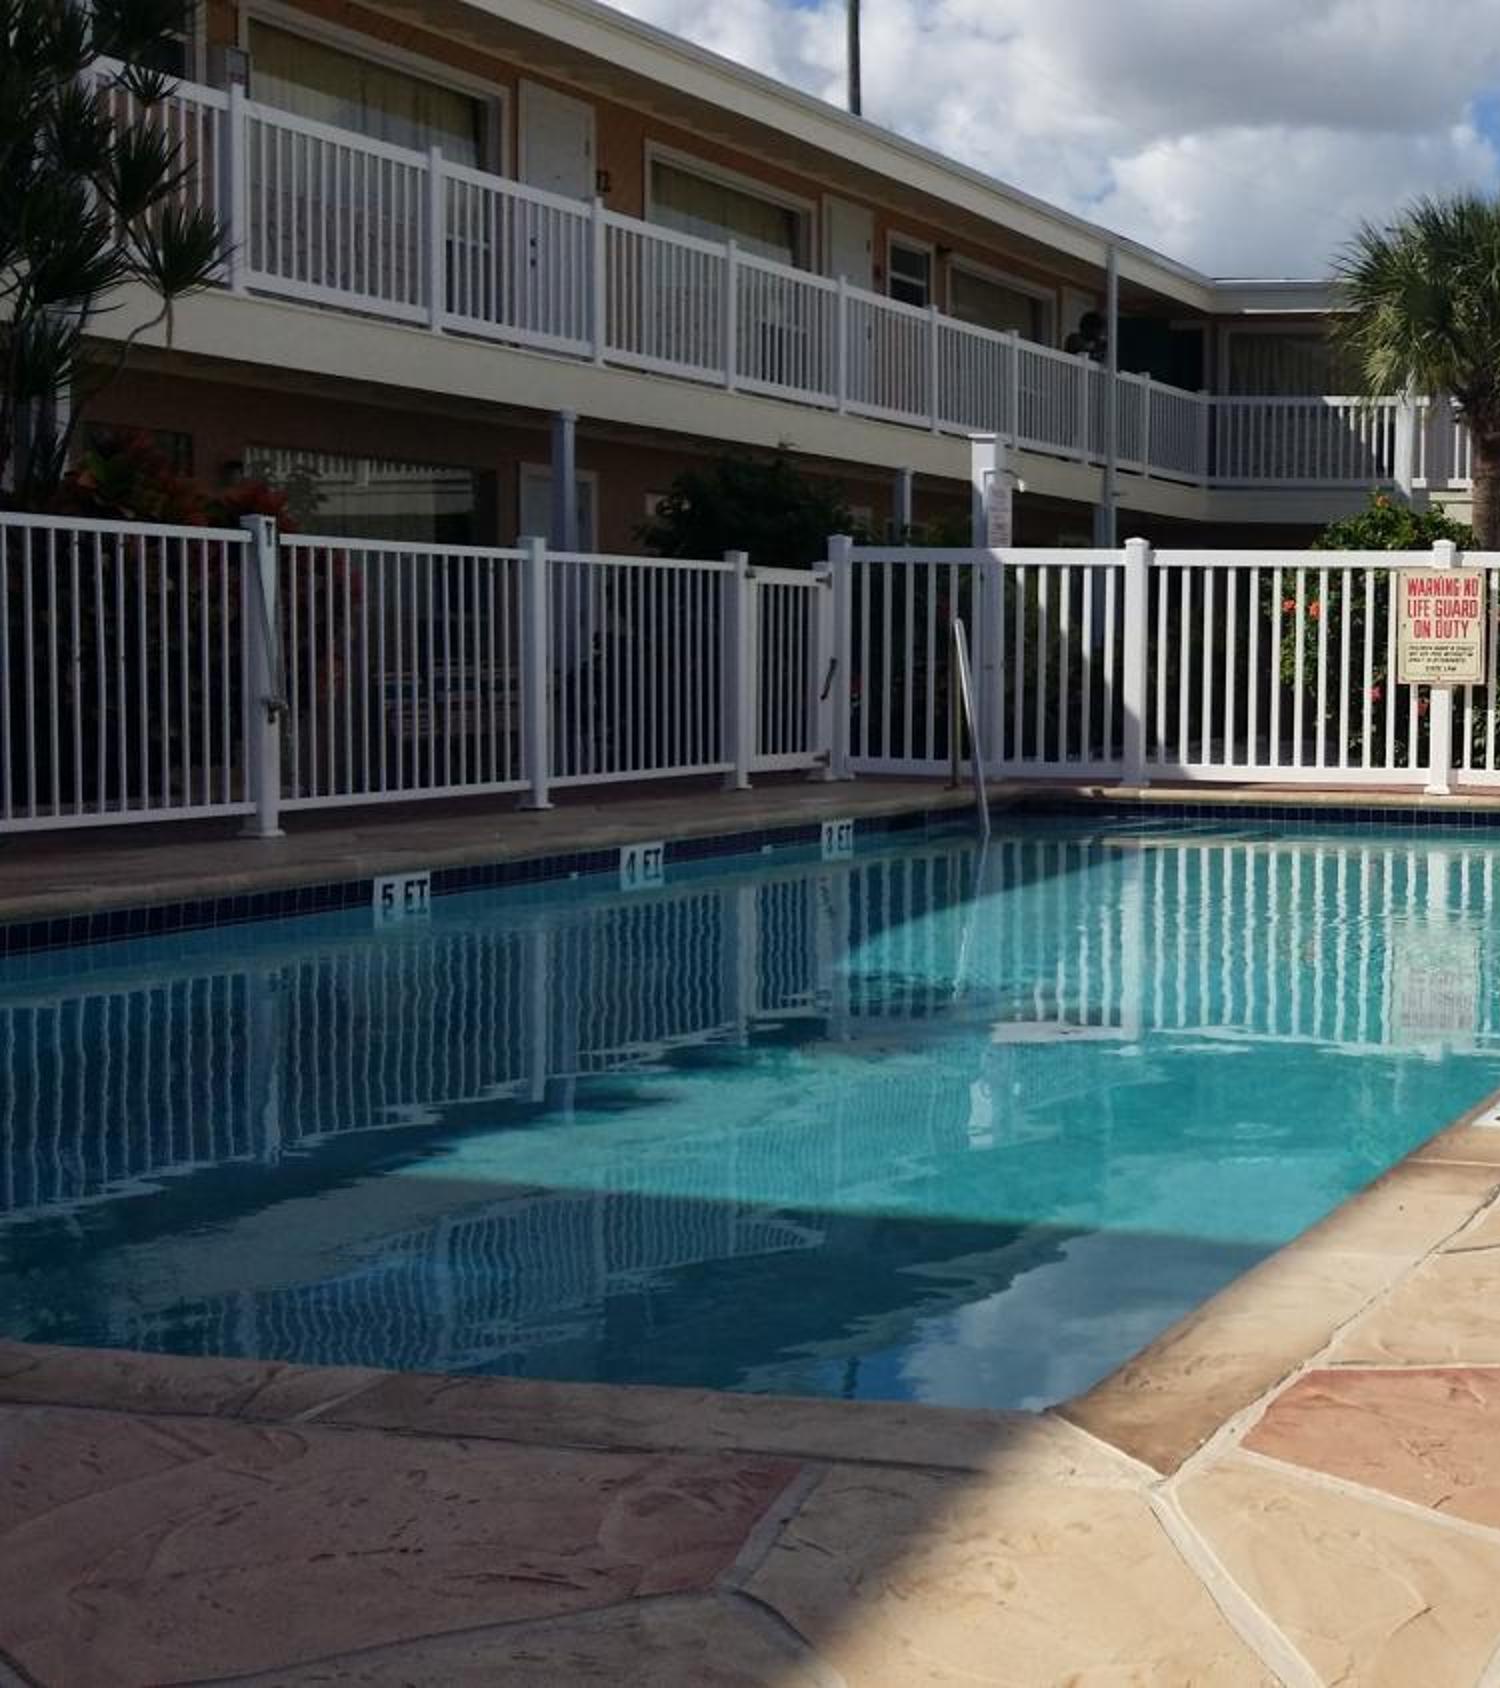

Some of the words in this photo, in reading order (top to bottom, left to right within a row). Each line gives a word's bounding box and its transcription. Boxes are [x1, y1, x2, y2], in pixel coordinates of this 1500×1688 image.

[1408, 577, 1459, 596] WARNING
[1464, 577, 1479, 596] NO
[1408, 600, 1431, 618] LIFE
[1436, 600, 1478, 618] GUARD
[1414, 620, 1431, 639] ON
[1436, 620, 1469, 639] DUTY
[383, 884, 394, 909] 5
[405, 880, 428, 906] FT
